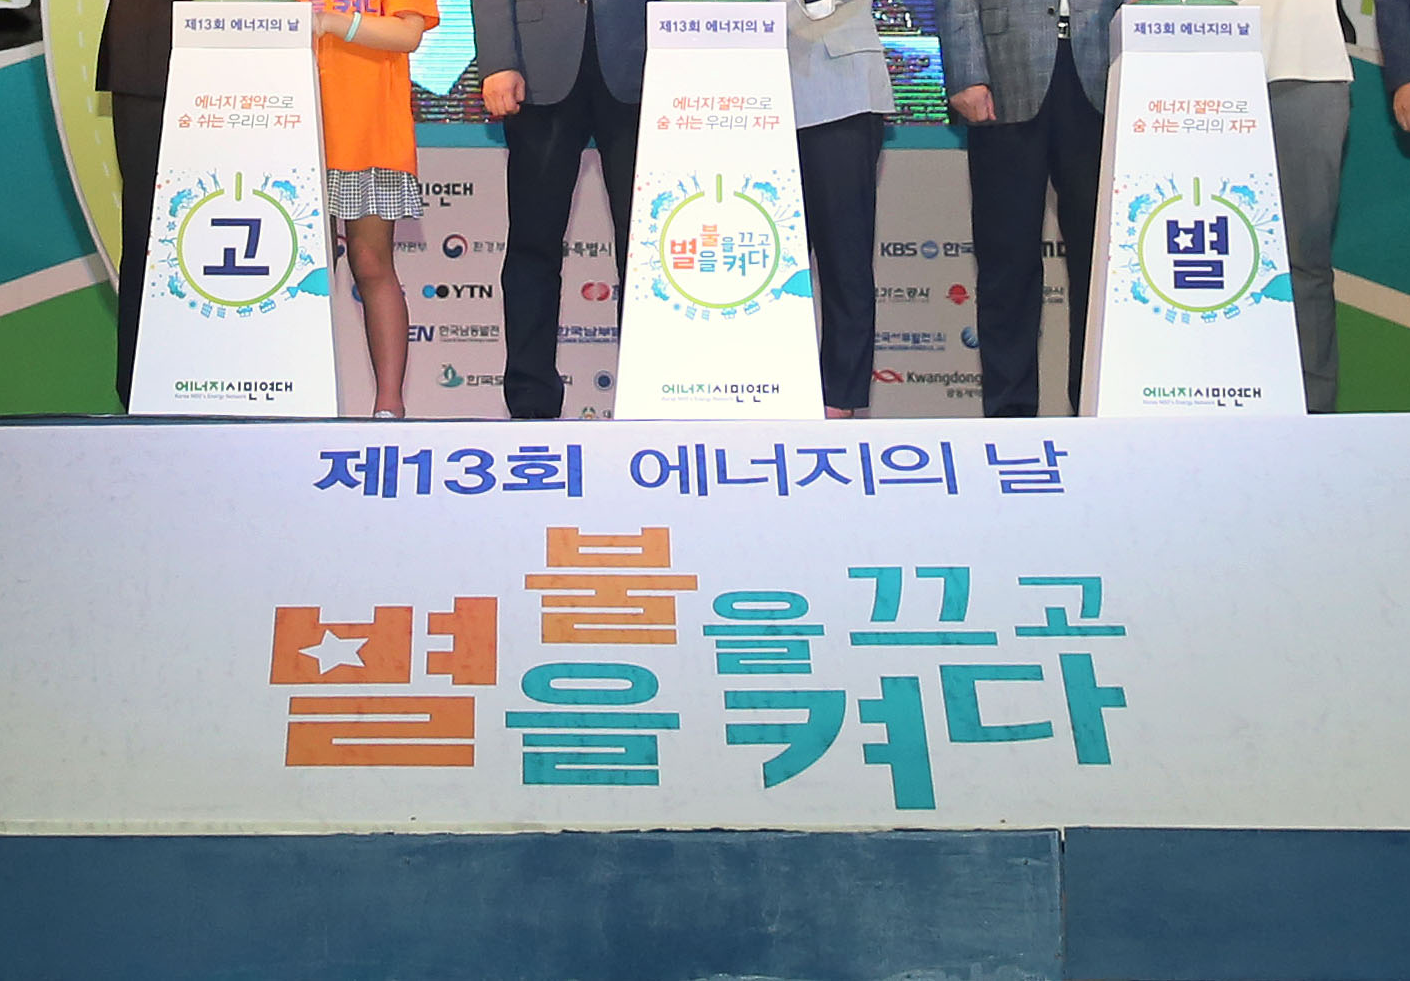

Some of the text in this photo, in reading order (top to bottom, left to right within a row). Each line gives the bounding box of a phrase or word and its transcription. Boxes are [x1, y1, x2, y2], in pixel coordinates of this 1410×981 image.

[185, 18, 299, 31] 제13회 에너지의 날
[659, 19, 775, 33] 제13회 에너지의 날
[1134, 22, 1250, 35] 제13회 에너지의 날
[195, 95, 294, 110] 에너지 절약으로
[672, 96, 772, 111] 에너지 절약으로
[1148, 100, 1249, 114] 에너지 절약으로
[178, 114, 302, 128] 숨 쉬는 우리의 지구
[656, 115, 781, 130] 숨 쉬는 우리의 지구
[1132, 118, 1257, 134] 숨 쉬는 우리의 지구
[700, 224, 771, 253] 불을 끄고
[203, 218, 269, 276] 고
[881, 242, 975, 257] KBS 한국
[1166, 216, 1229, 289] 별
[670, 238, 769, 276] 별을 켜다
[452, 284, 493, 298] YTN
[175, 381, 292, 400] 에너지시민연대
[662, 384, 779, 402] 에너지시민연대
[1143, 388, 1261, 407] 에너지시민연대
[313, 441, 1068, 498] 제13회 에너지의 날
[524, 526, 1127, 675] 불을 끄고
[269, 596, 1127, 811] 별을 켜다
